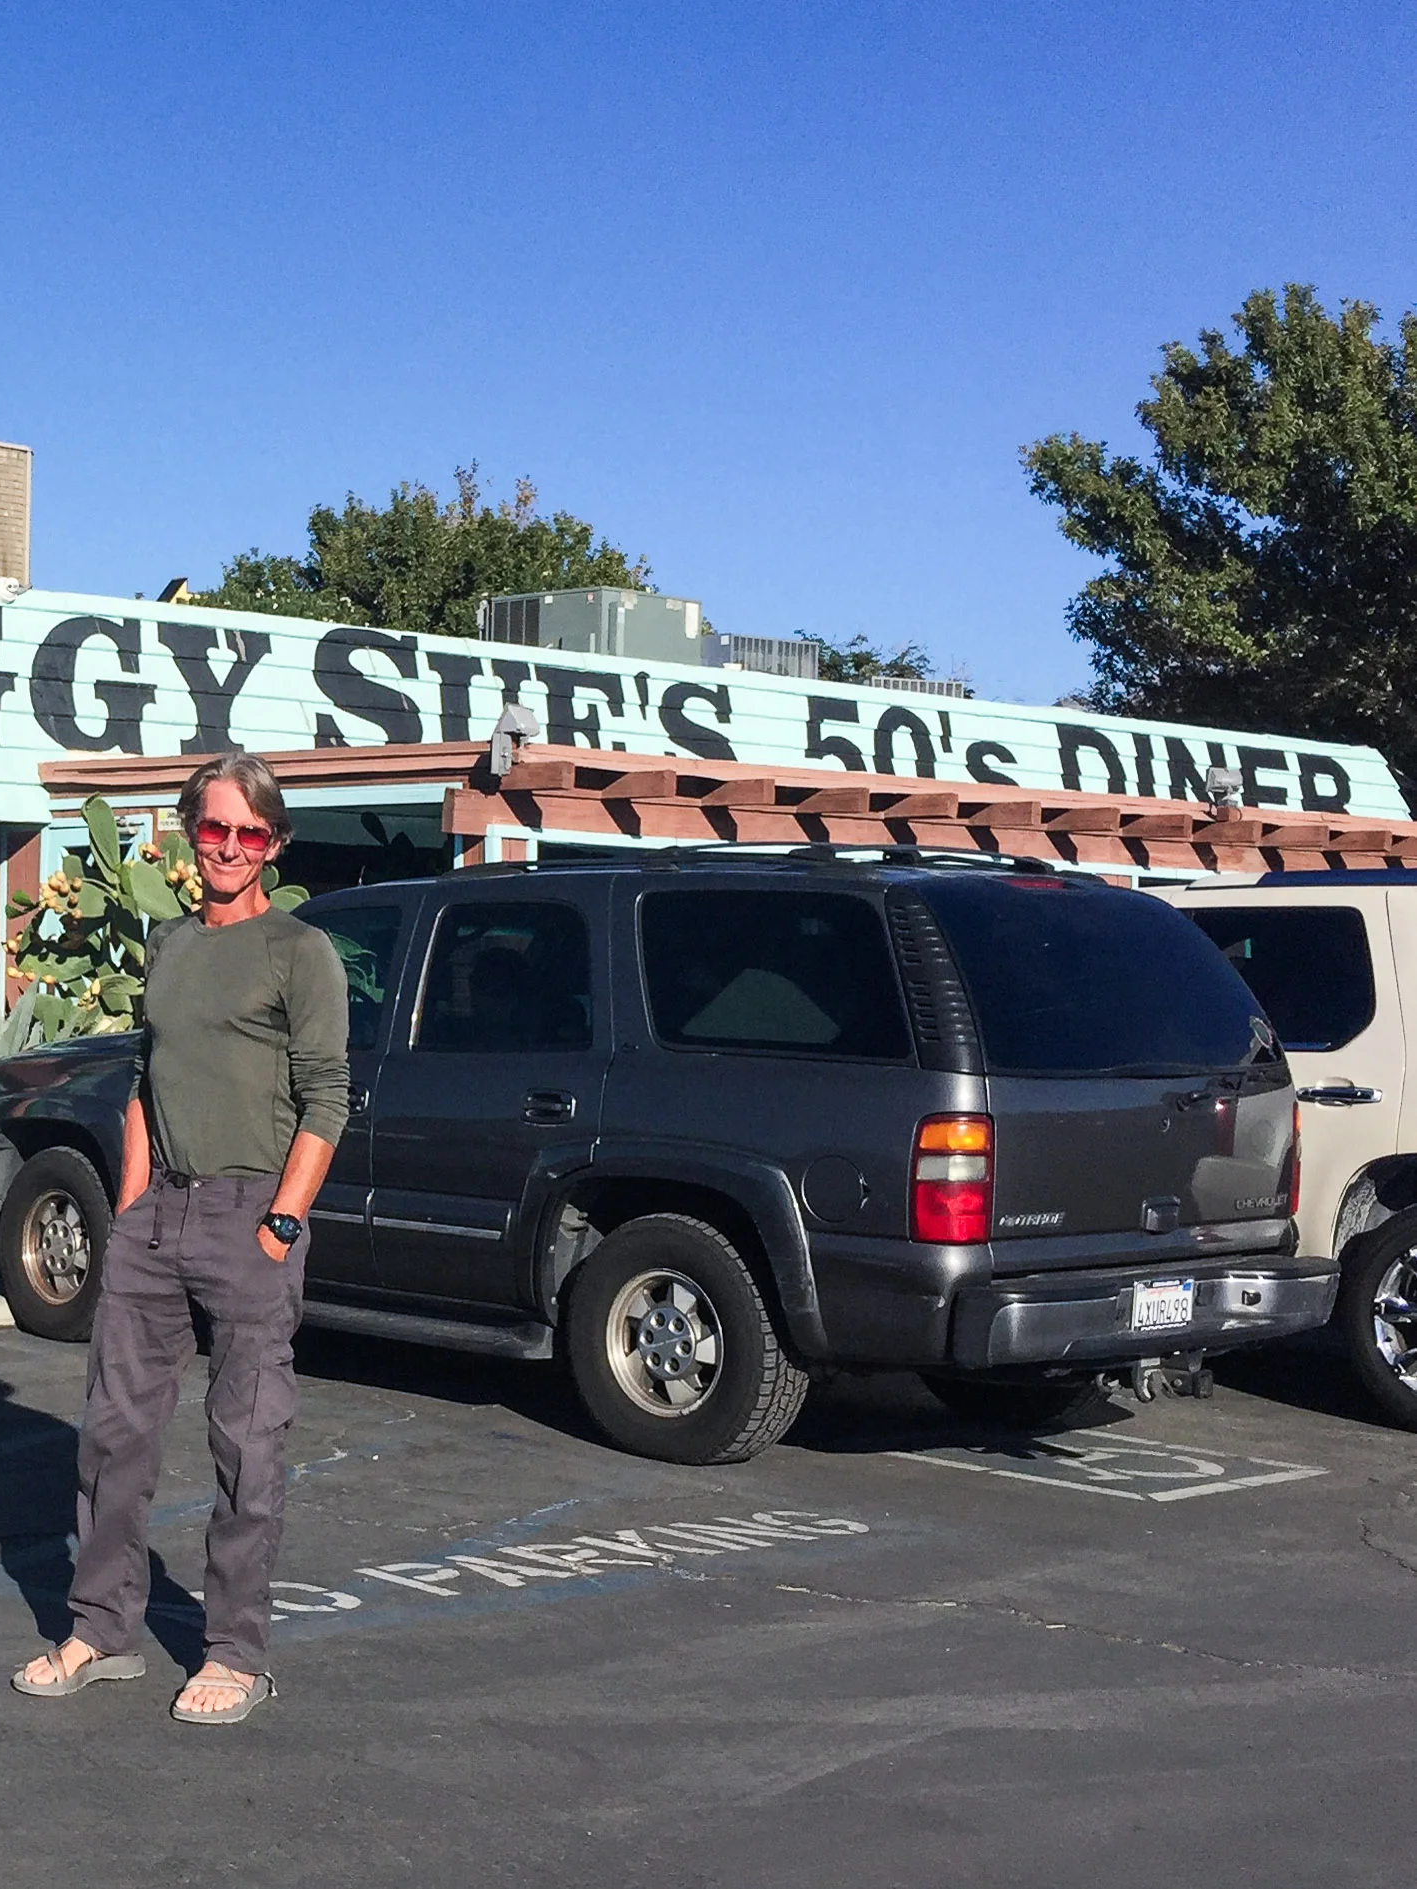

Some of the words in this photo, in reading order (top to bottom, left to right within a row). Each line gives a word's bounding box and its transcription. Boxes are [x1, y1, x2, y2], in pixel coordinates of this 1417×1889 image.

[314, 628, 736, 762] SUE'S
[1055, 722, 1353, 815] DINER
[1236, 1193, 1288, 1210] CHEVROLET
[354, 1509, 871, 1597] PARKING
